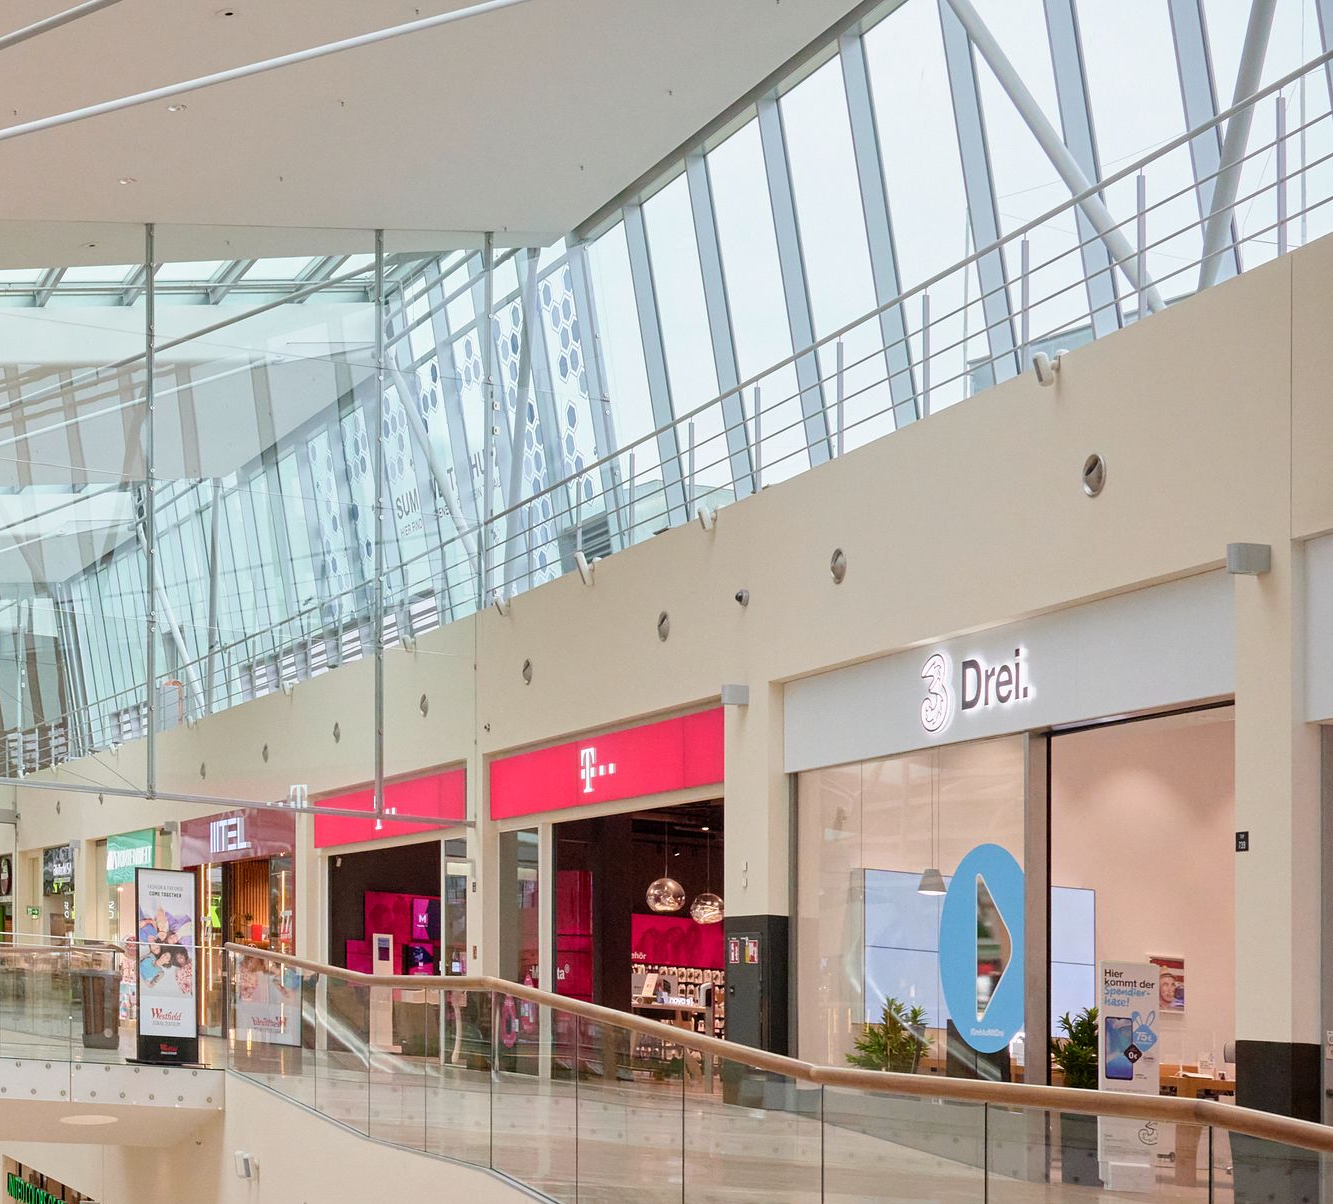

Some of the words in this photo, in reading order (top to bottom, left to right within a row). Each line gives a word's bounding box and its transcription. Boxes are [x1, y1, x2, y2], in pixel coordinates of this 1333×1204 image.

[960, 647, 1030, 712] Drei.
[161, 891, 182, 899] TOGETHER
[1104, 968, 1124, 978] Hier
[1104, 977, 1137, 988] kommt
[1139, 979, 1156, 989] der
[151, 1006, 183, 1021] Westfield
